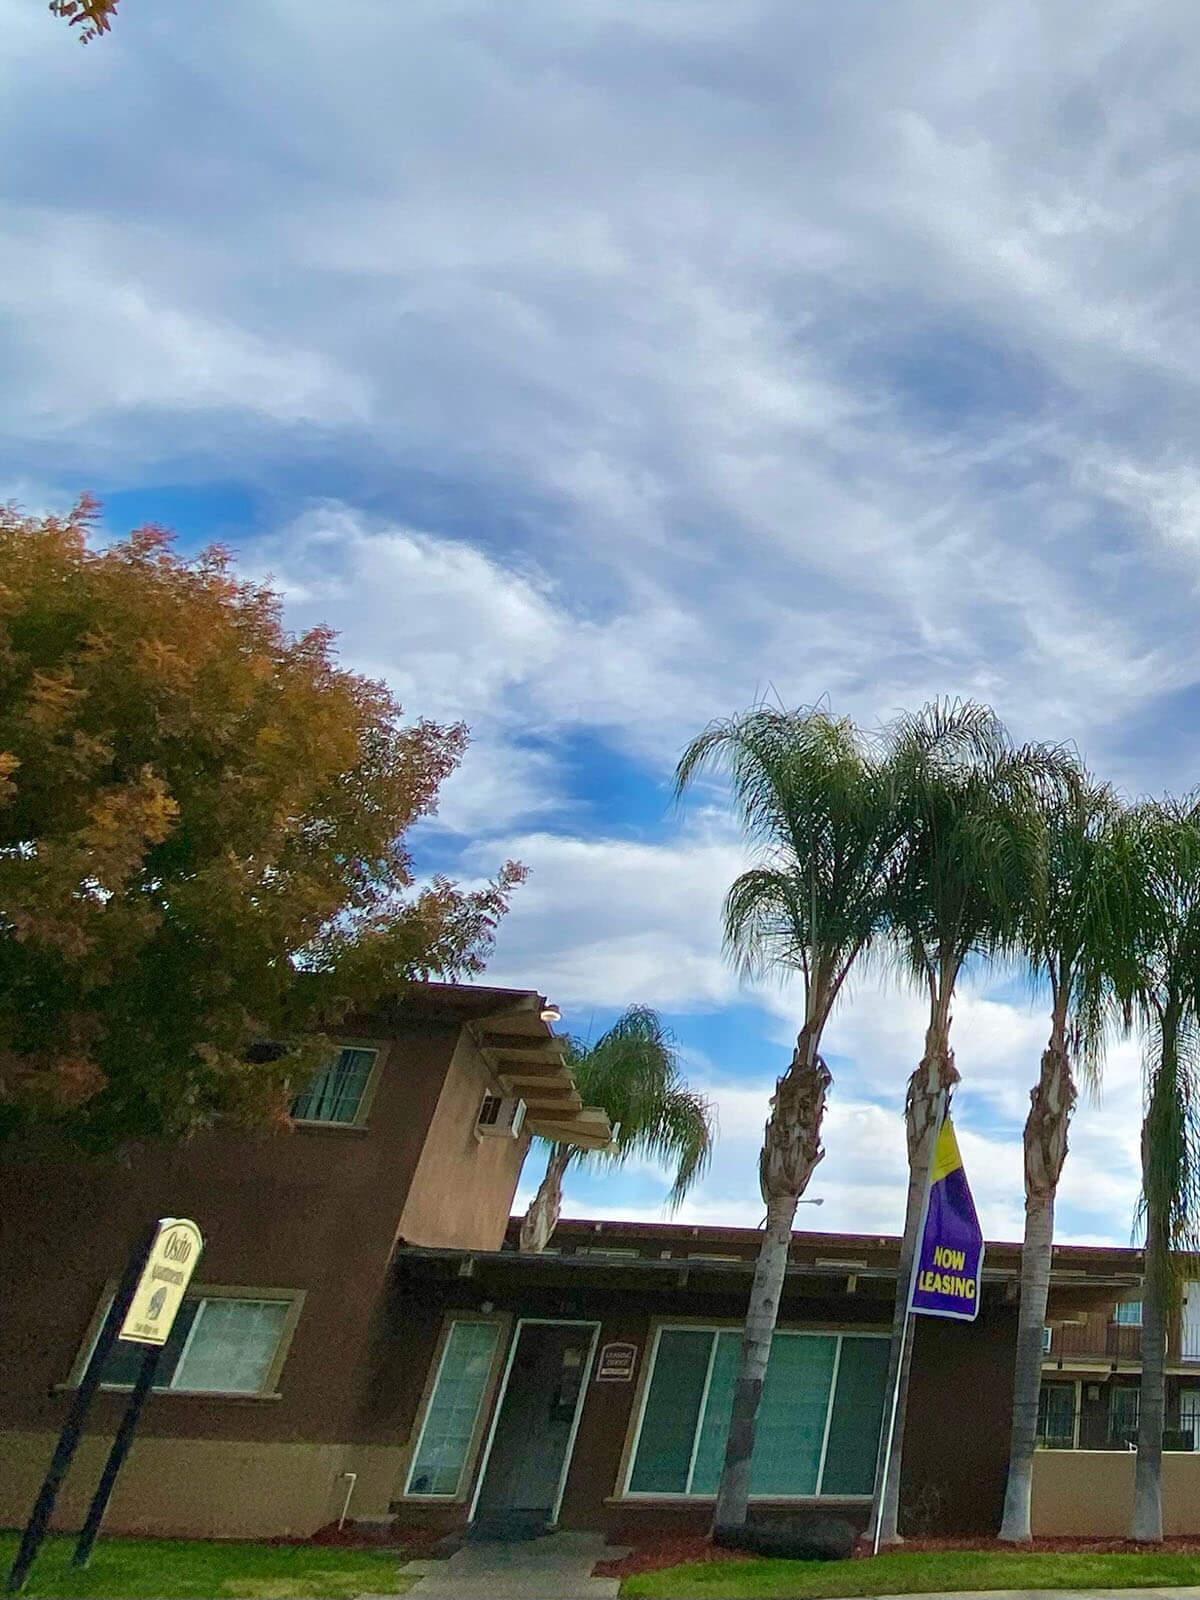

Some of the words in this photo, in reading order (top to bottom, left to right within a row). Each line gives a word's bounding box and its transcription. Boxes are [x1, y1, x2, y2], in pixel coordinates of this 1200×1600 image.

[164, 1231, 192, 1264] Osito
[933, 1245, 965, 1271] NOW
[918, 1270, 975, 1298] LEASING
